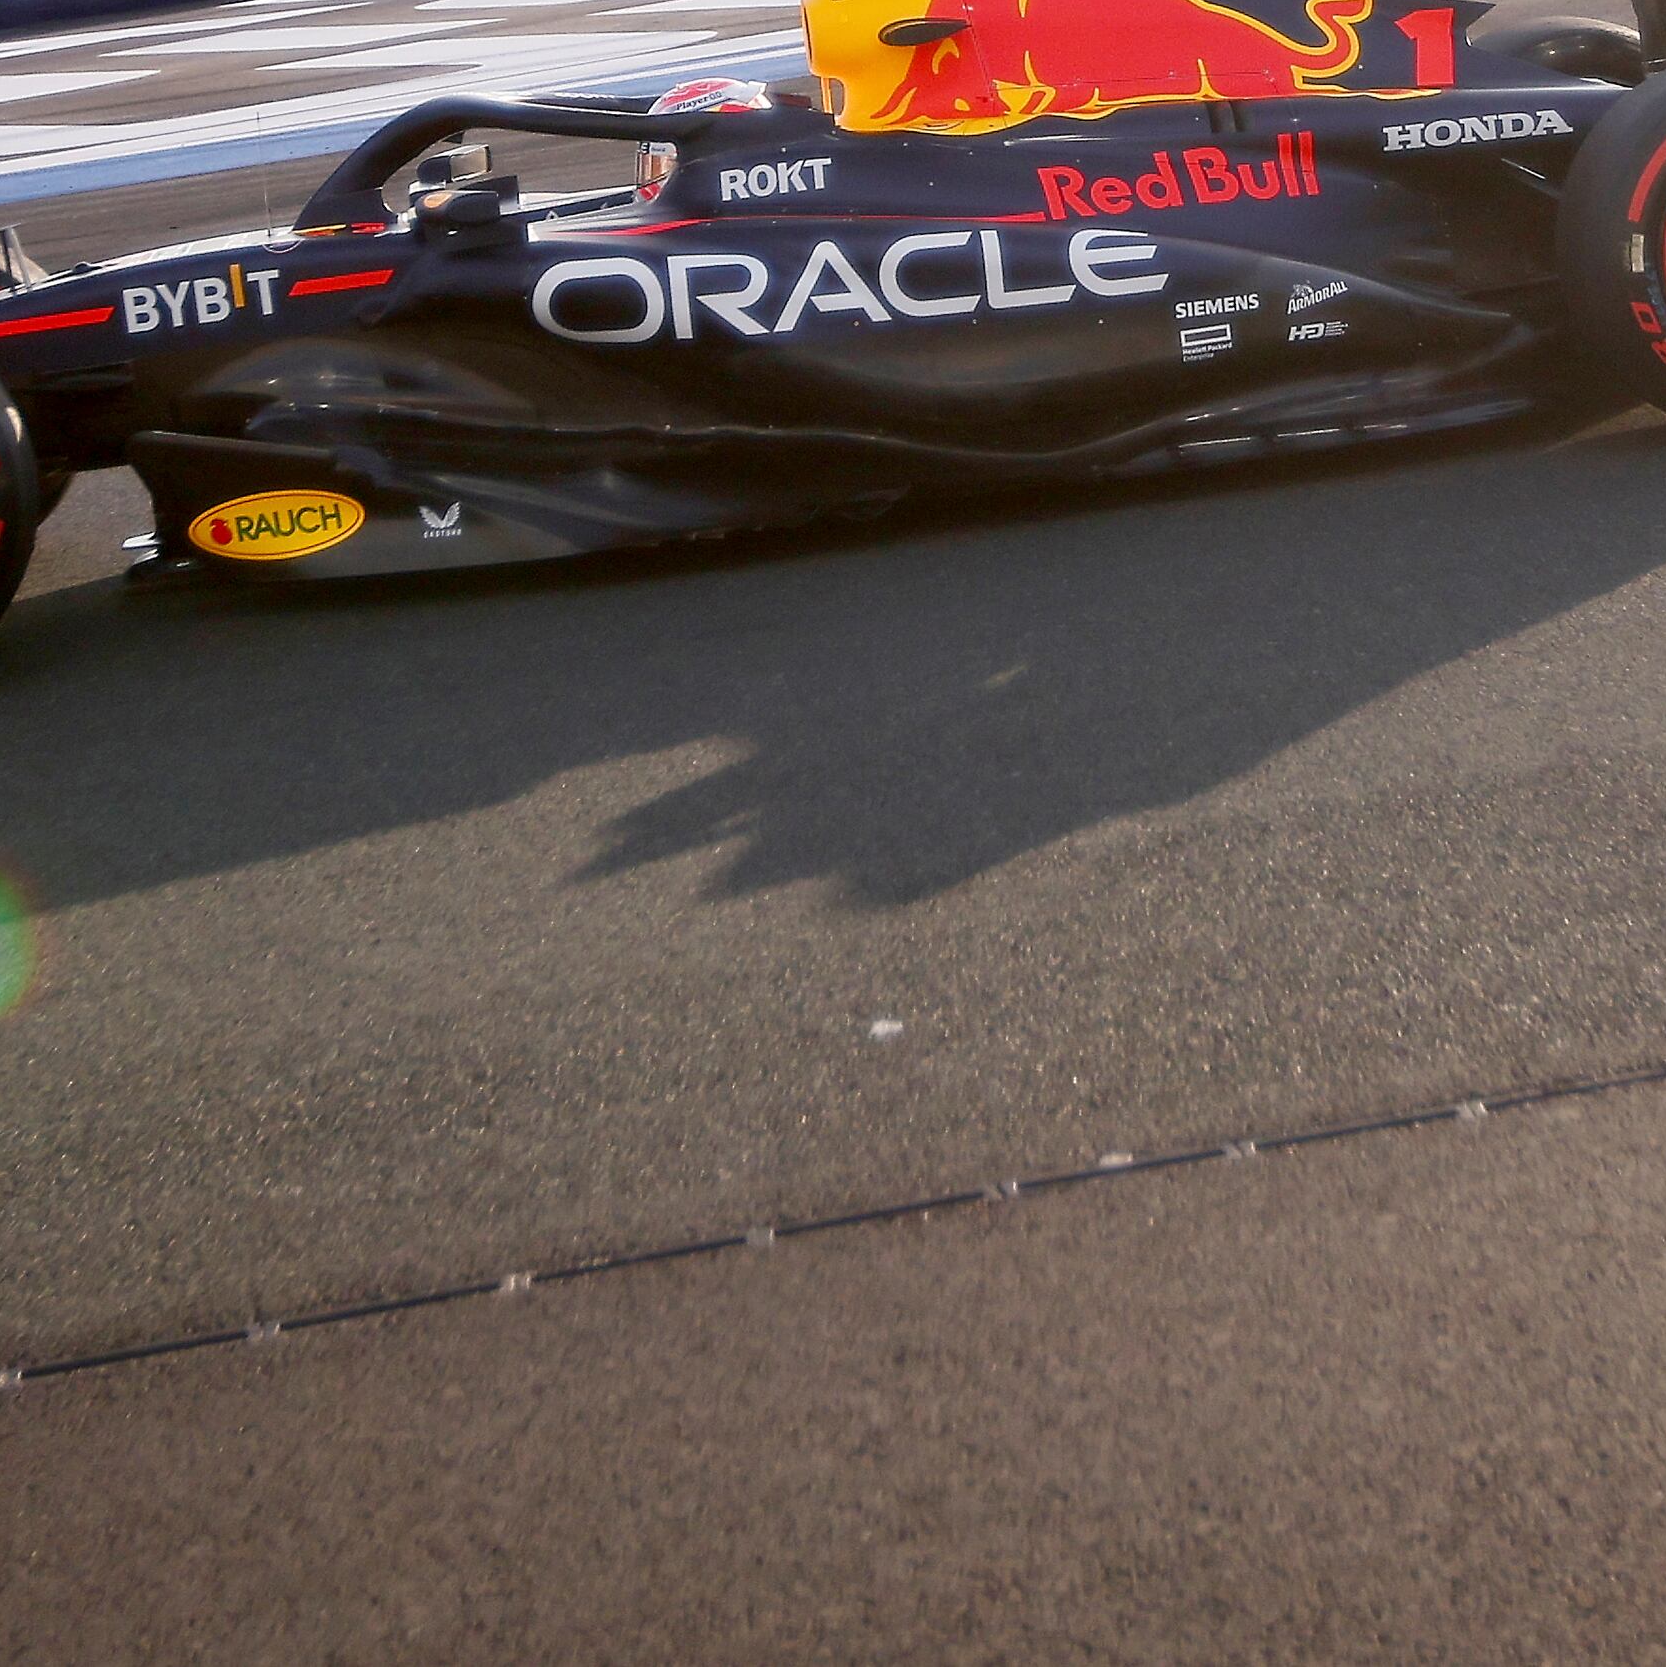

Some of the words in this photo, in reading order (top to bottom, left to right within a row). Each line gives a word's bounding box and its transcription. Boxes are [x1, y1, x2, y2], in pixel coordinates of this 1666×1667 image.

[1395, 8, 1455, 88] 1
[1383, 110, 1574, 152] HONDA
[720, 157, 832, 202] ROKT
[1038, 152, 1183, 222] Red
[1184, 131, 1321, 206] Bull
[121, 263, 280, 334] BYBIT
[530, 229, 1169, 342] ORACLE
[1175, 293, 1260, 319] SIEMENS
[235, 504, 343, 542] RAUCH
